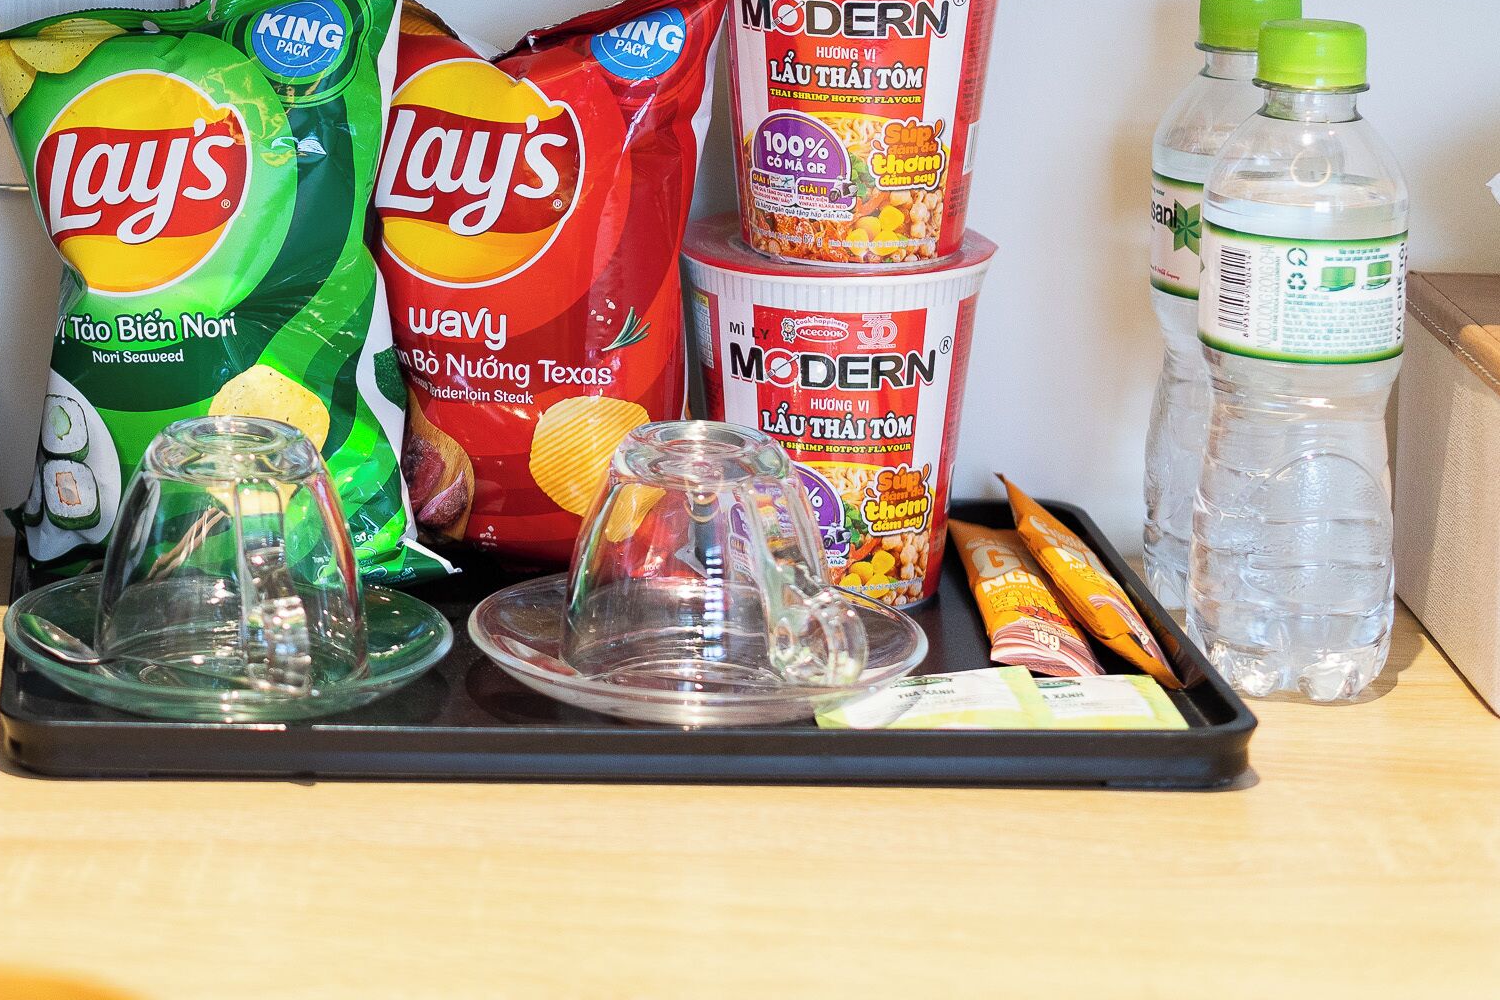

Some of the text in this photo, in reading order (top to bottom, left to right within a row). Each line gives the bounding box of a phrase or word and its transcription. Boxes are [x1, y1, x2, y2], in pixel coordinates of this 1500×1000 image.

[257, 13, 344, 50] KING
[276, 39, 311, 57] PACK
[614, 39, 650, 59] PACK
[816, 46, 876, 62] HƯƠNG VỊ
[770, 51, 924, 89] LẨU THÁI TÔM
[770, 89, 921, 104] THAI SHRIMP HOTPOT FLAVOUR
[763, 130, 829, 160] 100%
[375, 108, 569, 236] Lay's
[767, 154, 827, 174] CÓ MÃ QR
[872, 153, 940, 174] thơm
[50, 118, 236, 245] Lay's
[798, 183, 818, 194] GIẢI
[913, 173, 936, 186] say
[71, 315, 111, 341] Tảo
[116, 310, 176, 341] Biển
[182, 312, 237, 339] Nori
[408, 306, 506, 350] wavy
[729, 321, 769, 340] MÌ LY
[813, 317, 849, 329] happiness
[93, 349, 184, 363] Nori Seaweed
[729, 342, 936, 390] MODERN
[412, 349, 439, 375] Bò
[446, 353, 530, 388] Nướng
[538, 360, 612, 385] Texas
[428, 381, 490, 402] Tenderloin
[494, 390, 534, 405] Steak
[810, 398, 870, 414] HƯƠNG VỊ
[762, 402, 914, 440] LẨU THÁI TÔM
[786, 442, 824, 452] SHRIMP
[826, 444, 866, 454] HOTPOT
[867, 443, 911, 454] FLAVOUR
[877, 467, 921, 492] Súp
[865, 497, 928, 521] thơm
[904, 515, 923, 529] say
[1030, 629, 1060, 652] 16g
